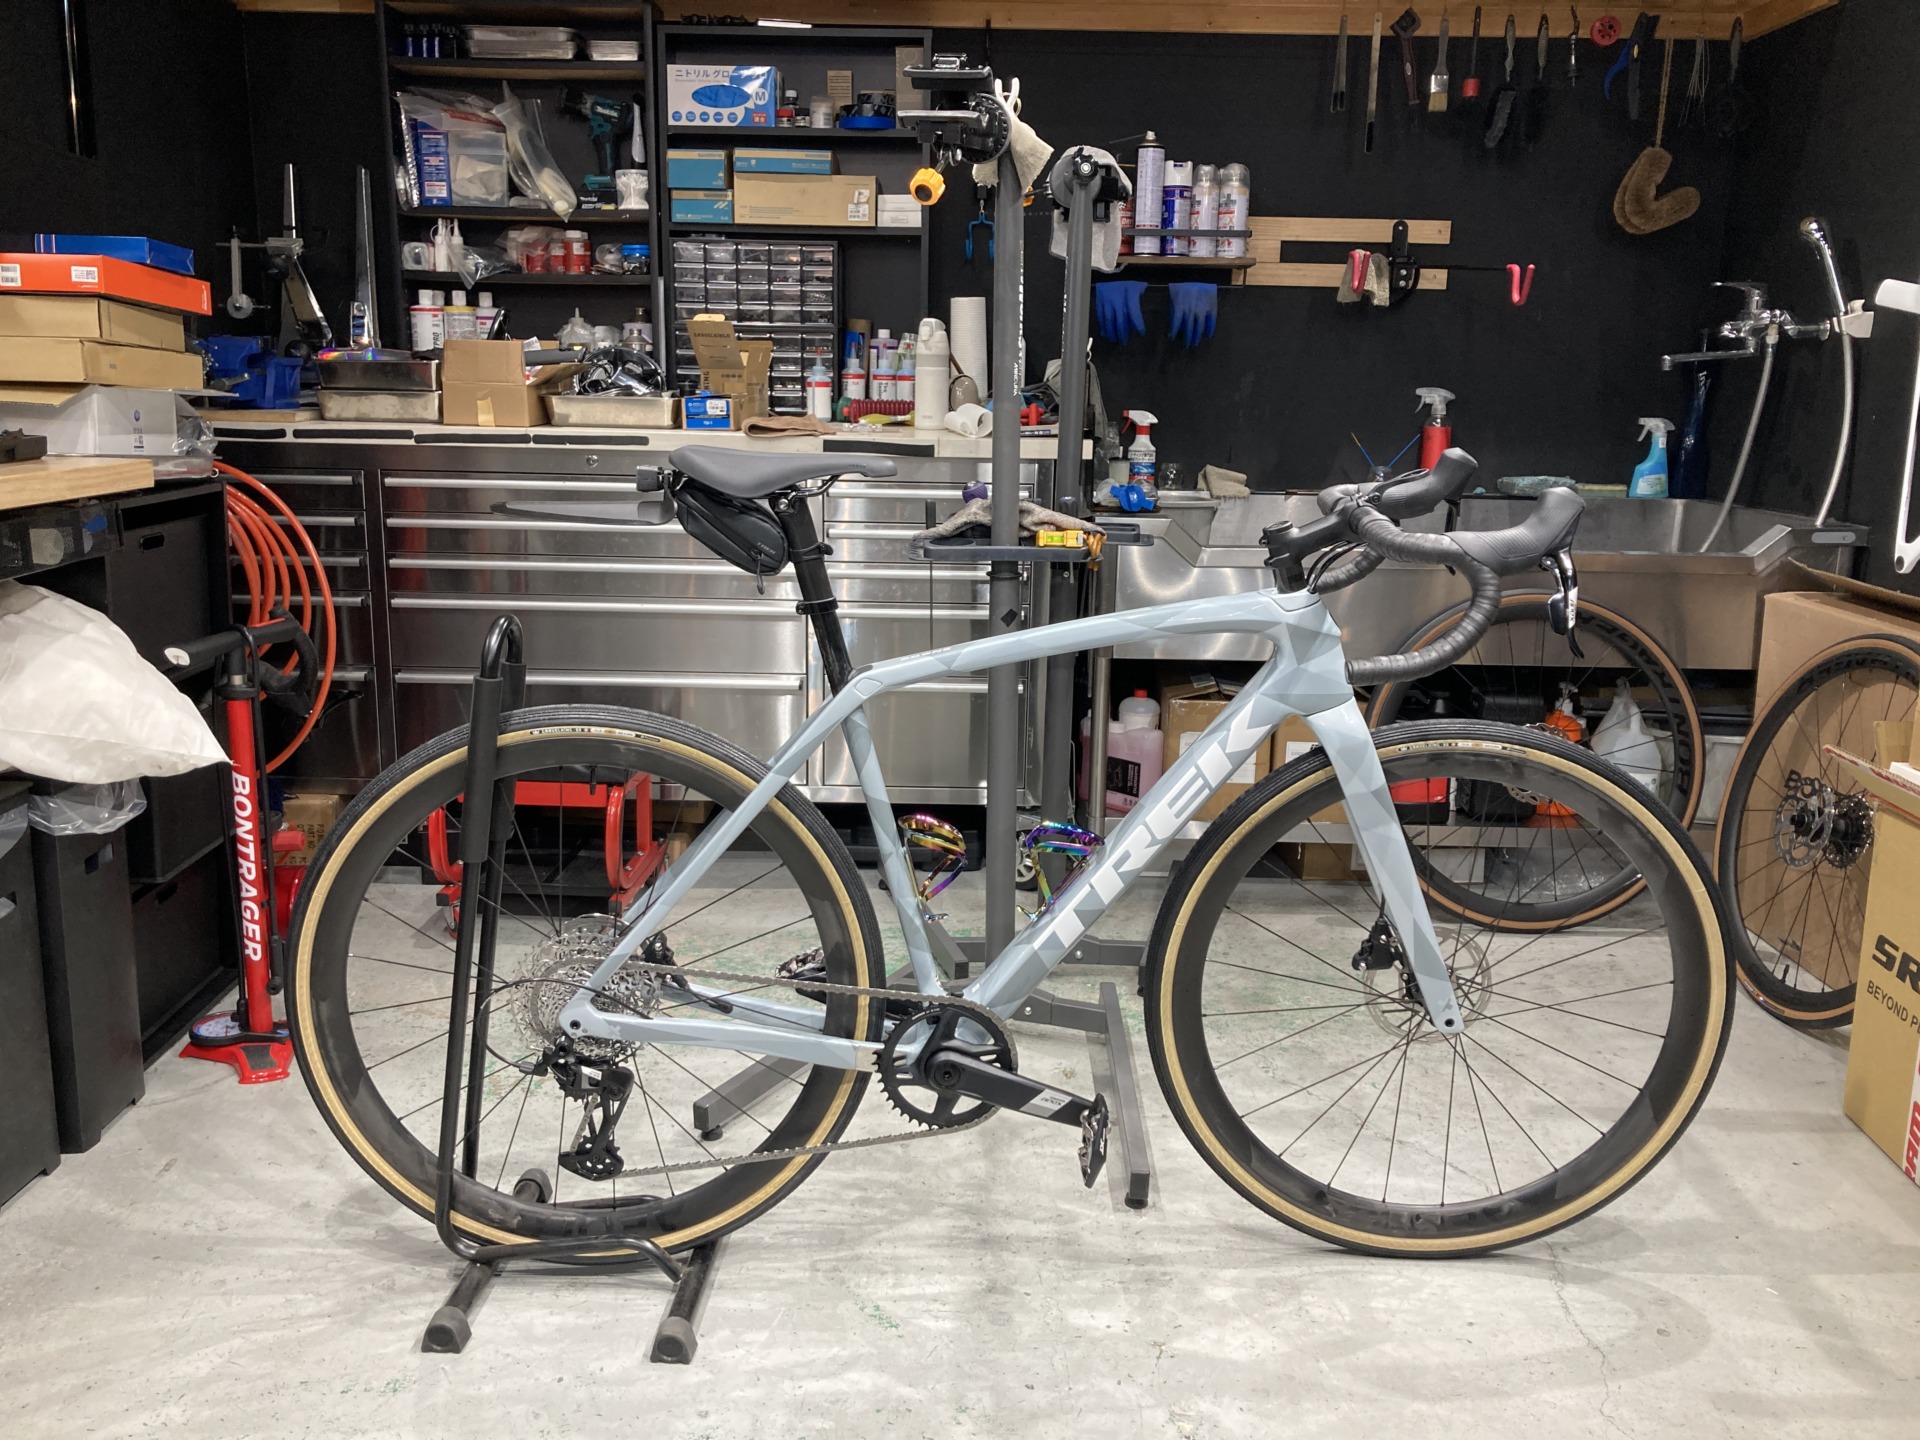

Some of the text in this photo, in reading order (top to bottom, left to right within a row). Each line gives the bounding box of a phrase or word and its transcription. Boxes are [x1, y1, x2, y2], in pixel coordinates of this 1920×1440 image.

[675, 69, 710, 78] ニトリル
[755, 91, 766, 102] M
[1033, 700, 1273, 950] TREK
[231, 770, 262, 963] BONTRAGER
[1867, 979, 1909, 1022] BEYOND
